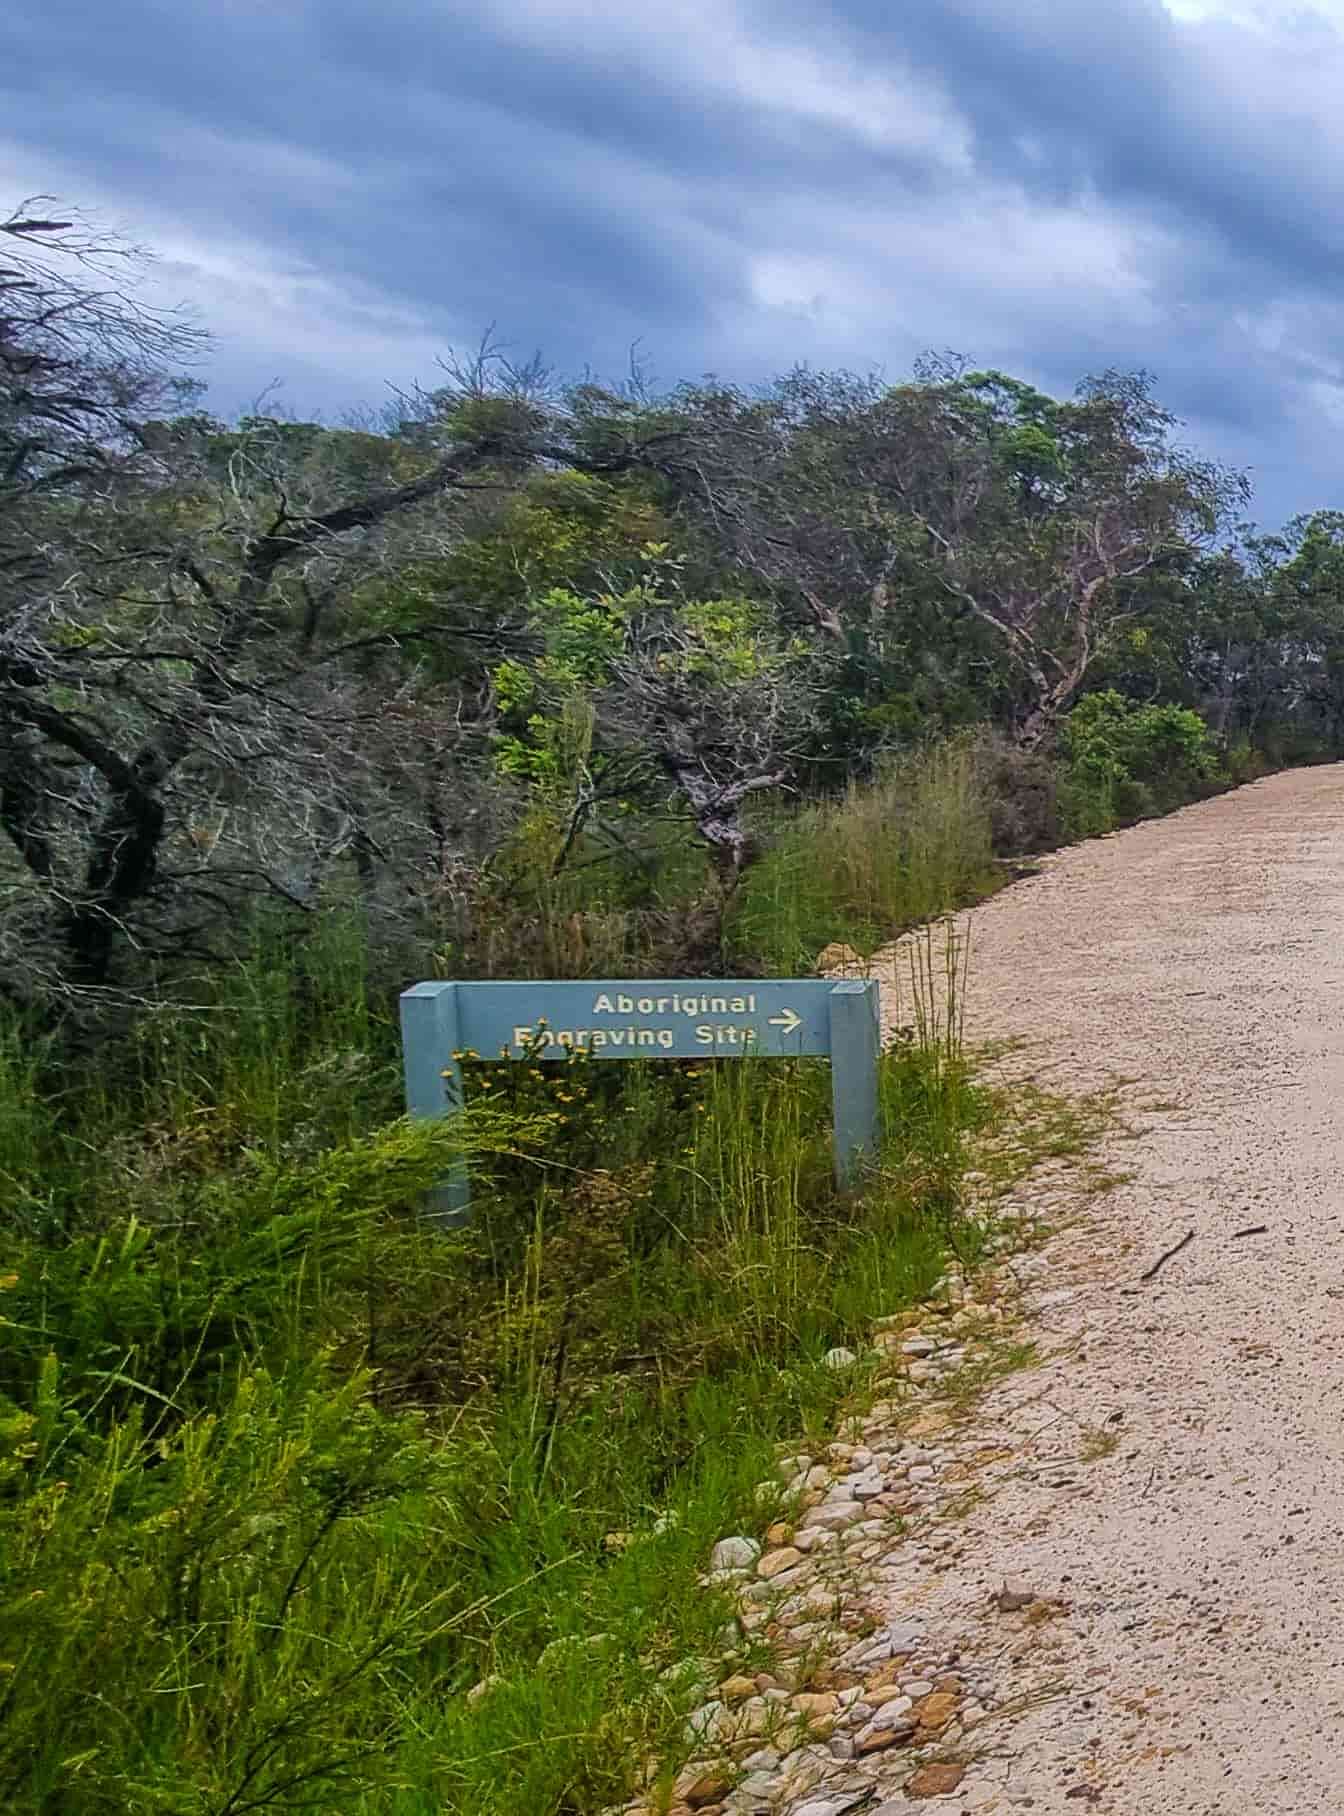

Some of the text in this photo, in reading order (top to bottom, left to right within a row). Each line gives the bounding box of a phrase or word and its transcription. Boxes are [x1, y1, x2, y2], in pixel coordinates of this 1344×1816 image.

[593, 993, 756, 1016] Aboriginal
[513, 1025, 757, 1048] Engraving Site
